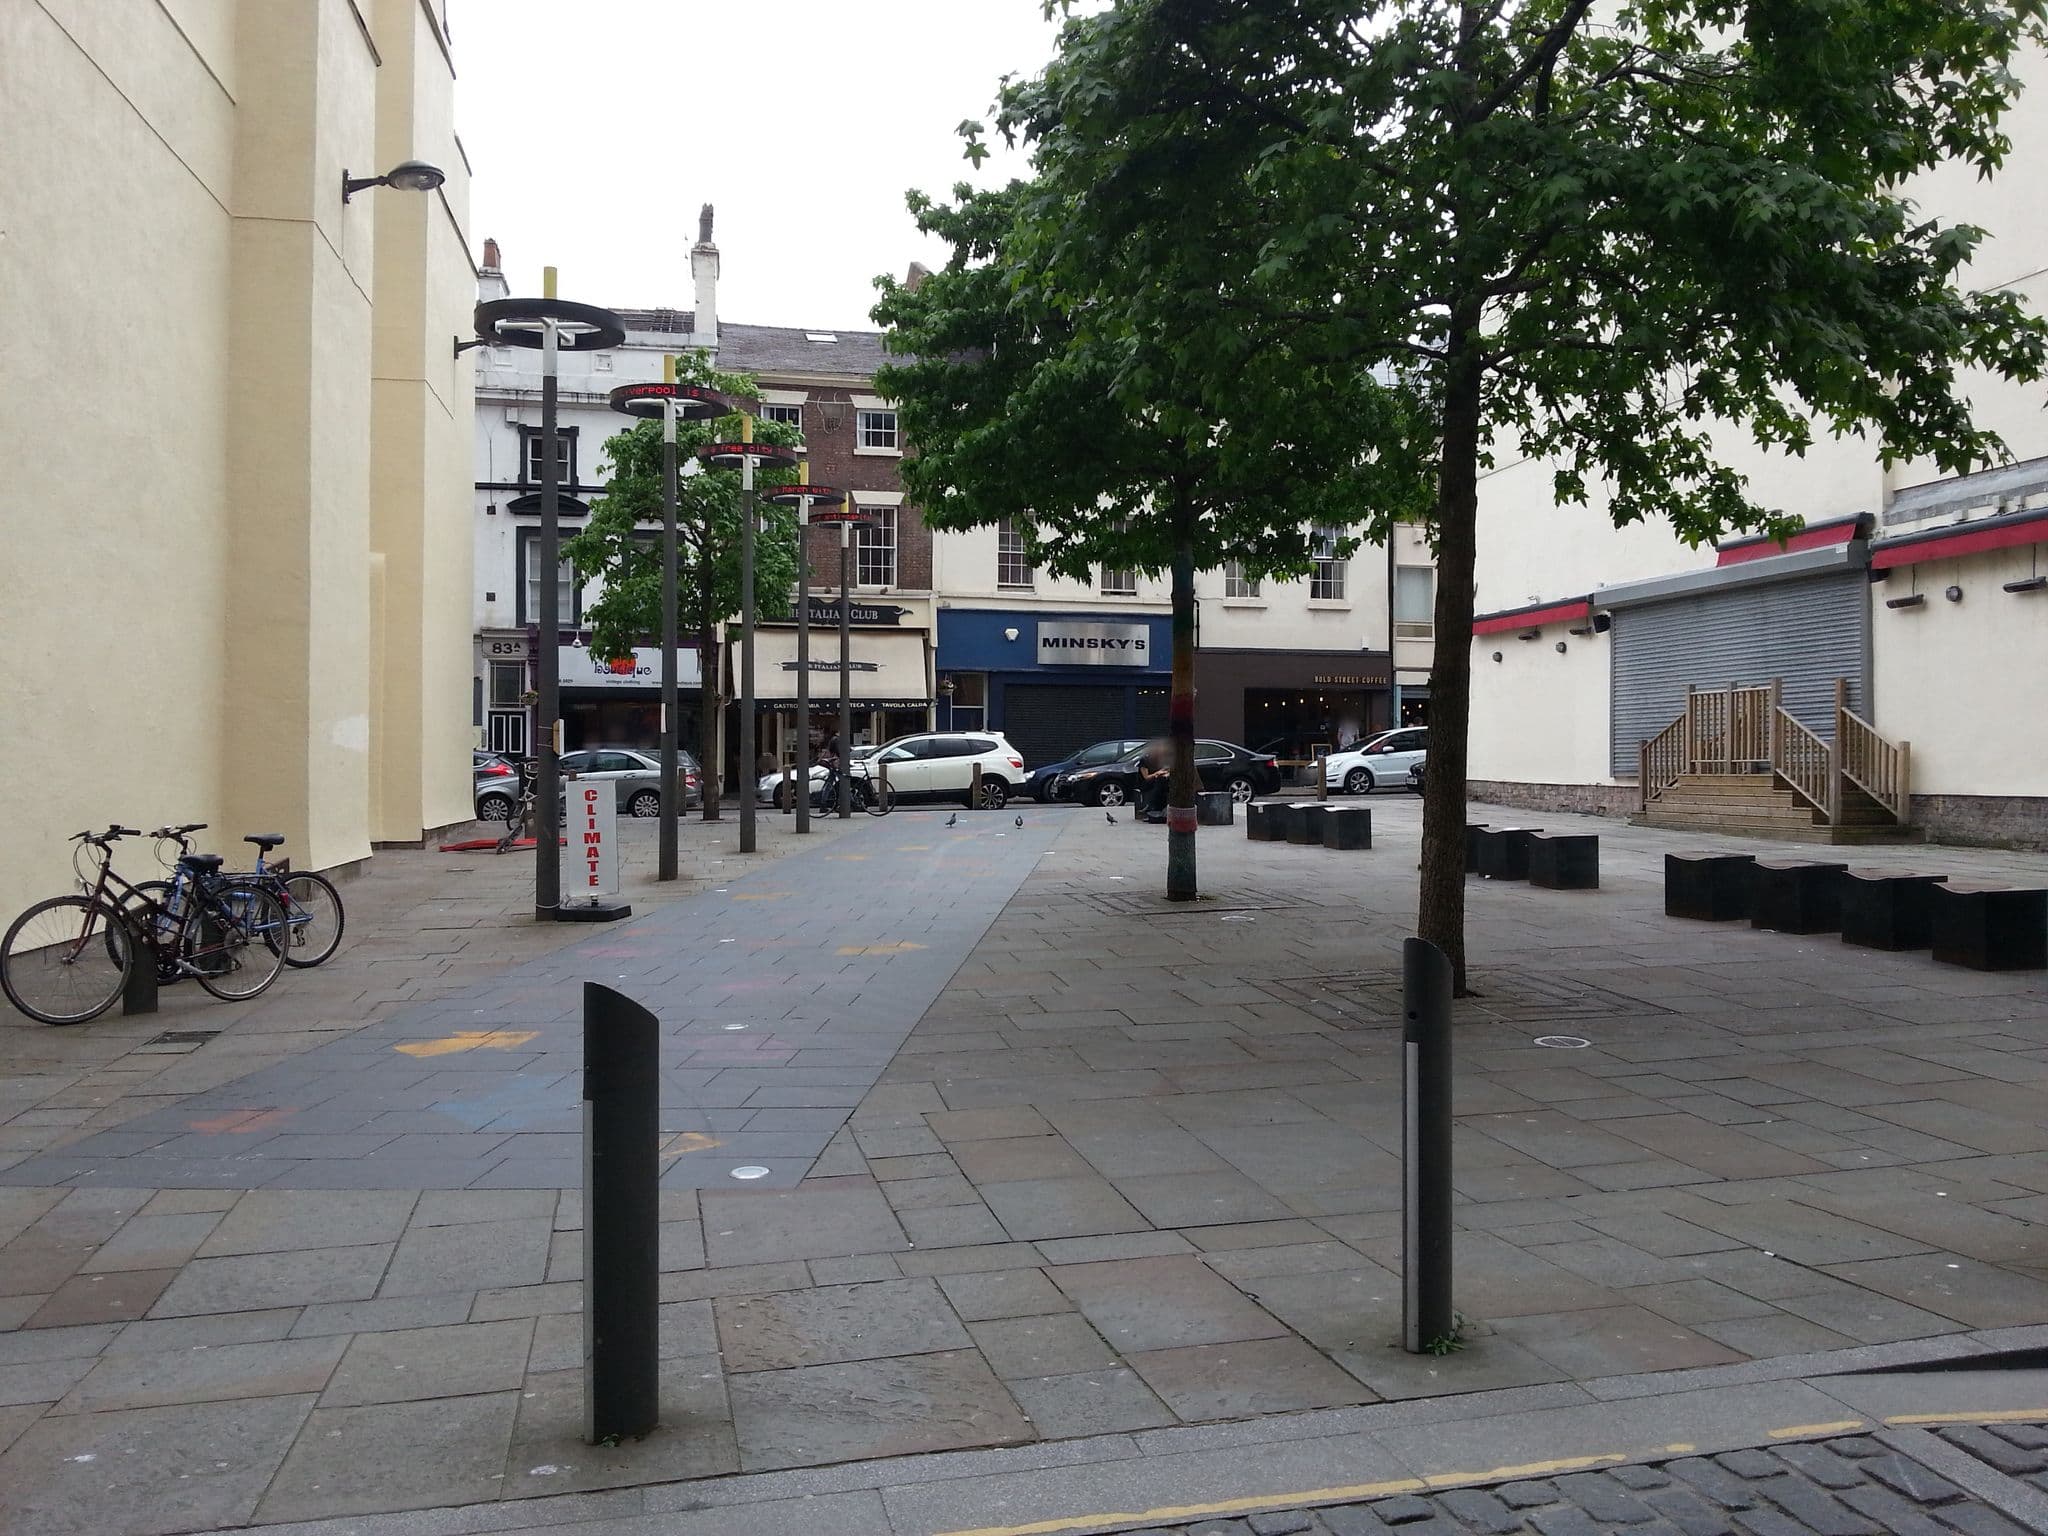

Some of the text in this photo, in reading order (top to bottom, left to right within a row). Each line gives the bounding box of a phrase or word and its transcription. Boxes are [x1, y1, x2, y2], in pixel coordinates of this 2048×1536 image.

[808, 608, 841, 619] TALIA
[850, 609, 879, 620] CLUB
[1042, 637, 1146, 650] MINSKY'S
[1334, 676, 1359, 684] STREET
[1362, 676, 1387, 684] COFFEE
[584, 789, 601, 886] CLIMATE
